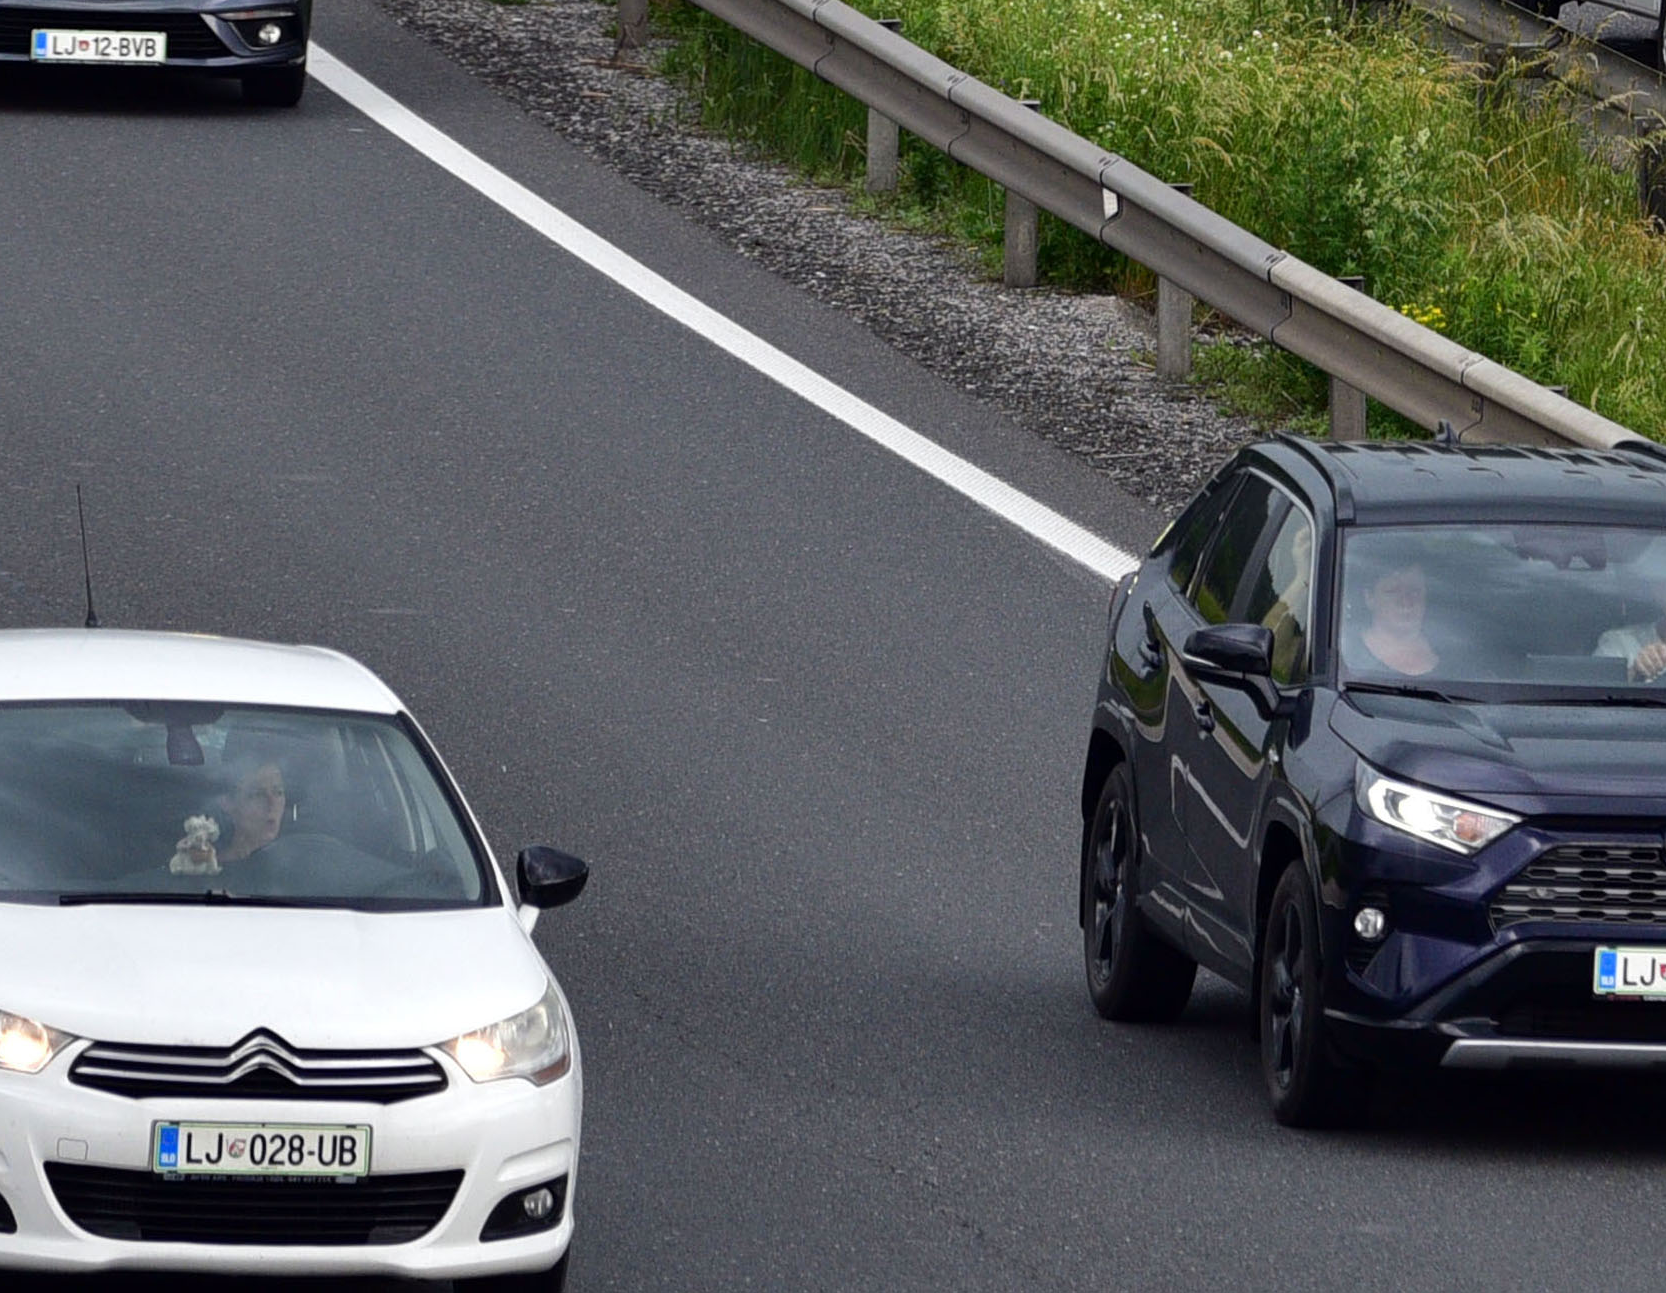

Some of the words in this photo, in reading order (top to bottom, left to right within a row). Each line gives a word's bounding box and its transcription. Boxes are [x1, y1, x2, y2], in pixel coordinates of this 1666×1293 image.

[53, 36, 76, 55] LJ
[92, 37, 156, 57] 12-BVB
[1623, 957, 1656, 987] LJ
[186, 1132, 223, 1165] LJ
[249, 1133, 358, 1168] 028-UB
